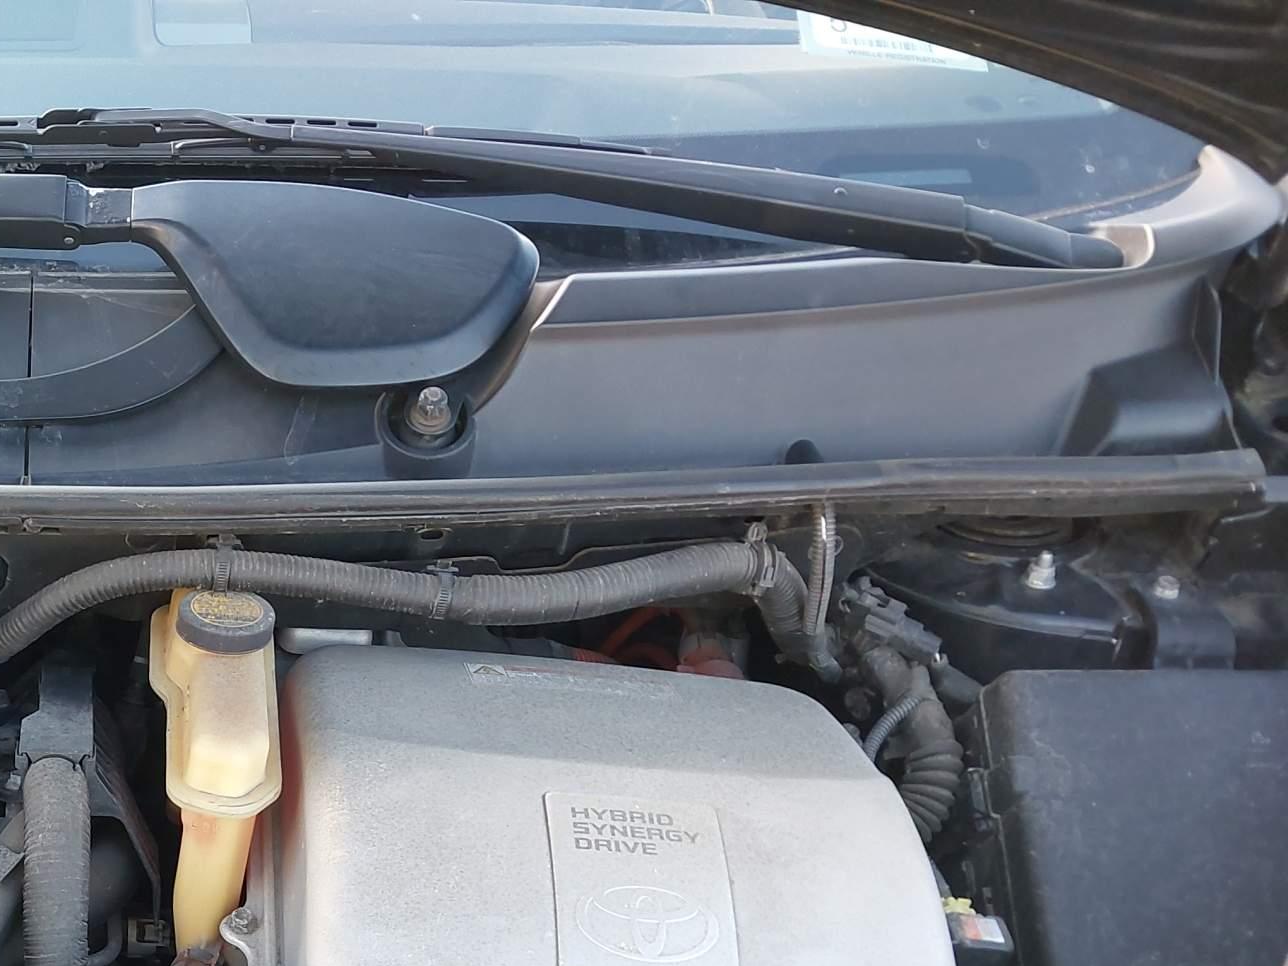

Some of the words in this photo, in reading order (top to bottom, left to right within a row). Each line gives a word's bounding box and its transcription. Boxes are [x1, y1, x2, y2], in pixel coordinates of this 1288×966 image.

[571, 806, 674, 826] HYBRID
[572, 821, 700, 844] SYNERGY
[574, 837, 658, 856] DRIVE
